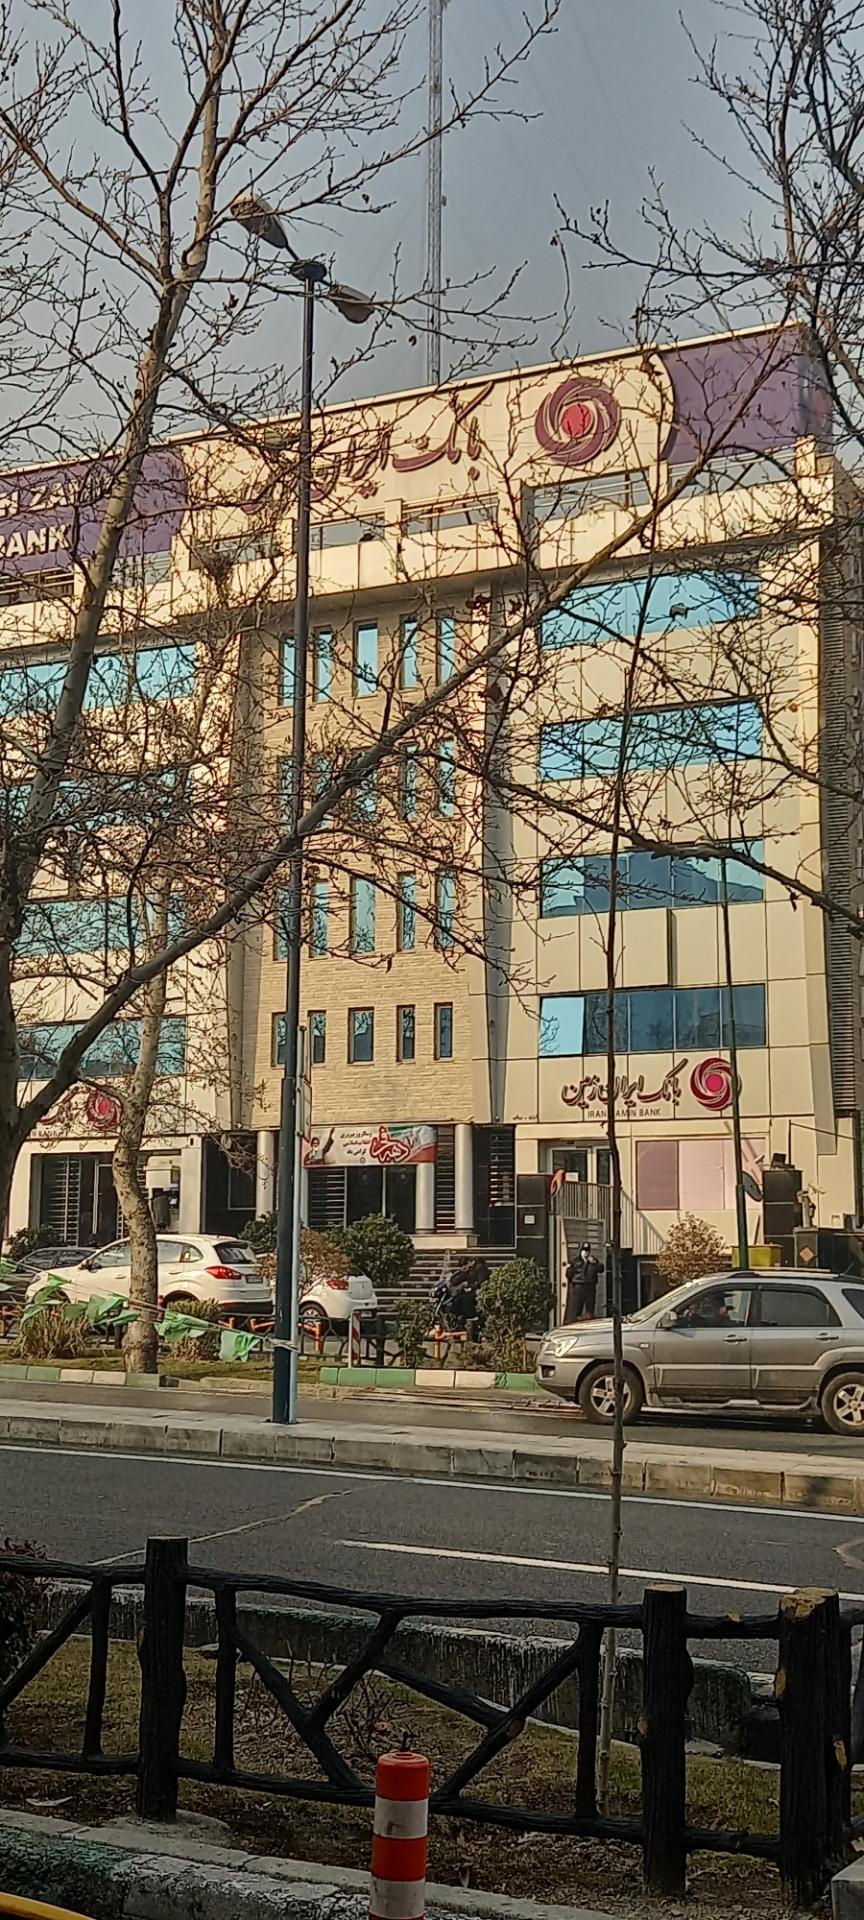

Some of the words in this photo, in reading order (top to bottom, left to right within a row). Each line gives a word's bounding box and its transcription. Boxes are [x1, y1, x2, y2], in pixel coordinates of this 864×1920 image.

[392, 380, 494, 482] بانک
[0, 523, 71, 559] ANK
[561, 1074, 601, 1109] زمین
[597, 1075, 645, 1108] ایران
[637, 1058, 689, 1106] بانک
[587, 1110, 607, 1119] IRAN
[610, 1108, 637, 1118] AMIN
[639, 1108, 661, 1117] BANK
